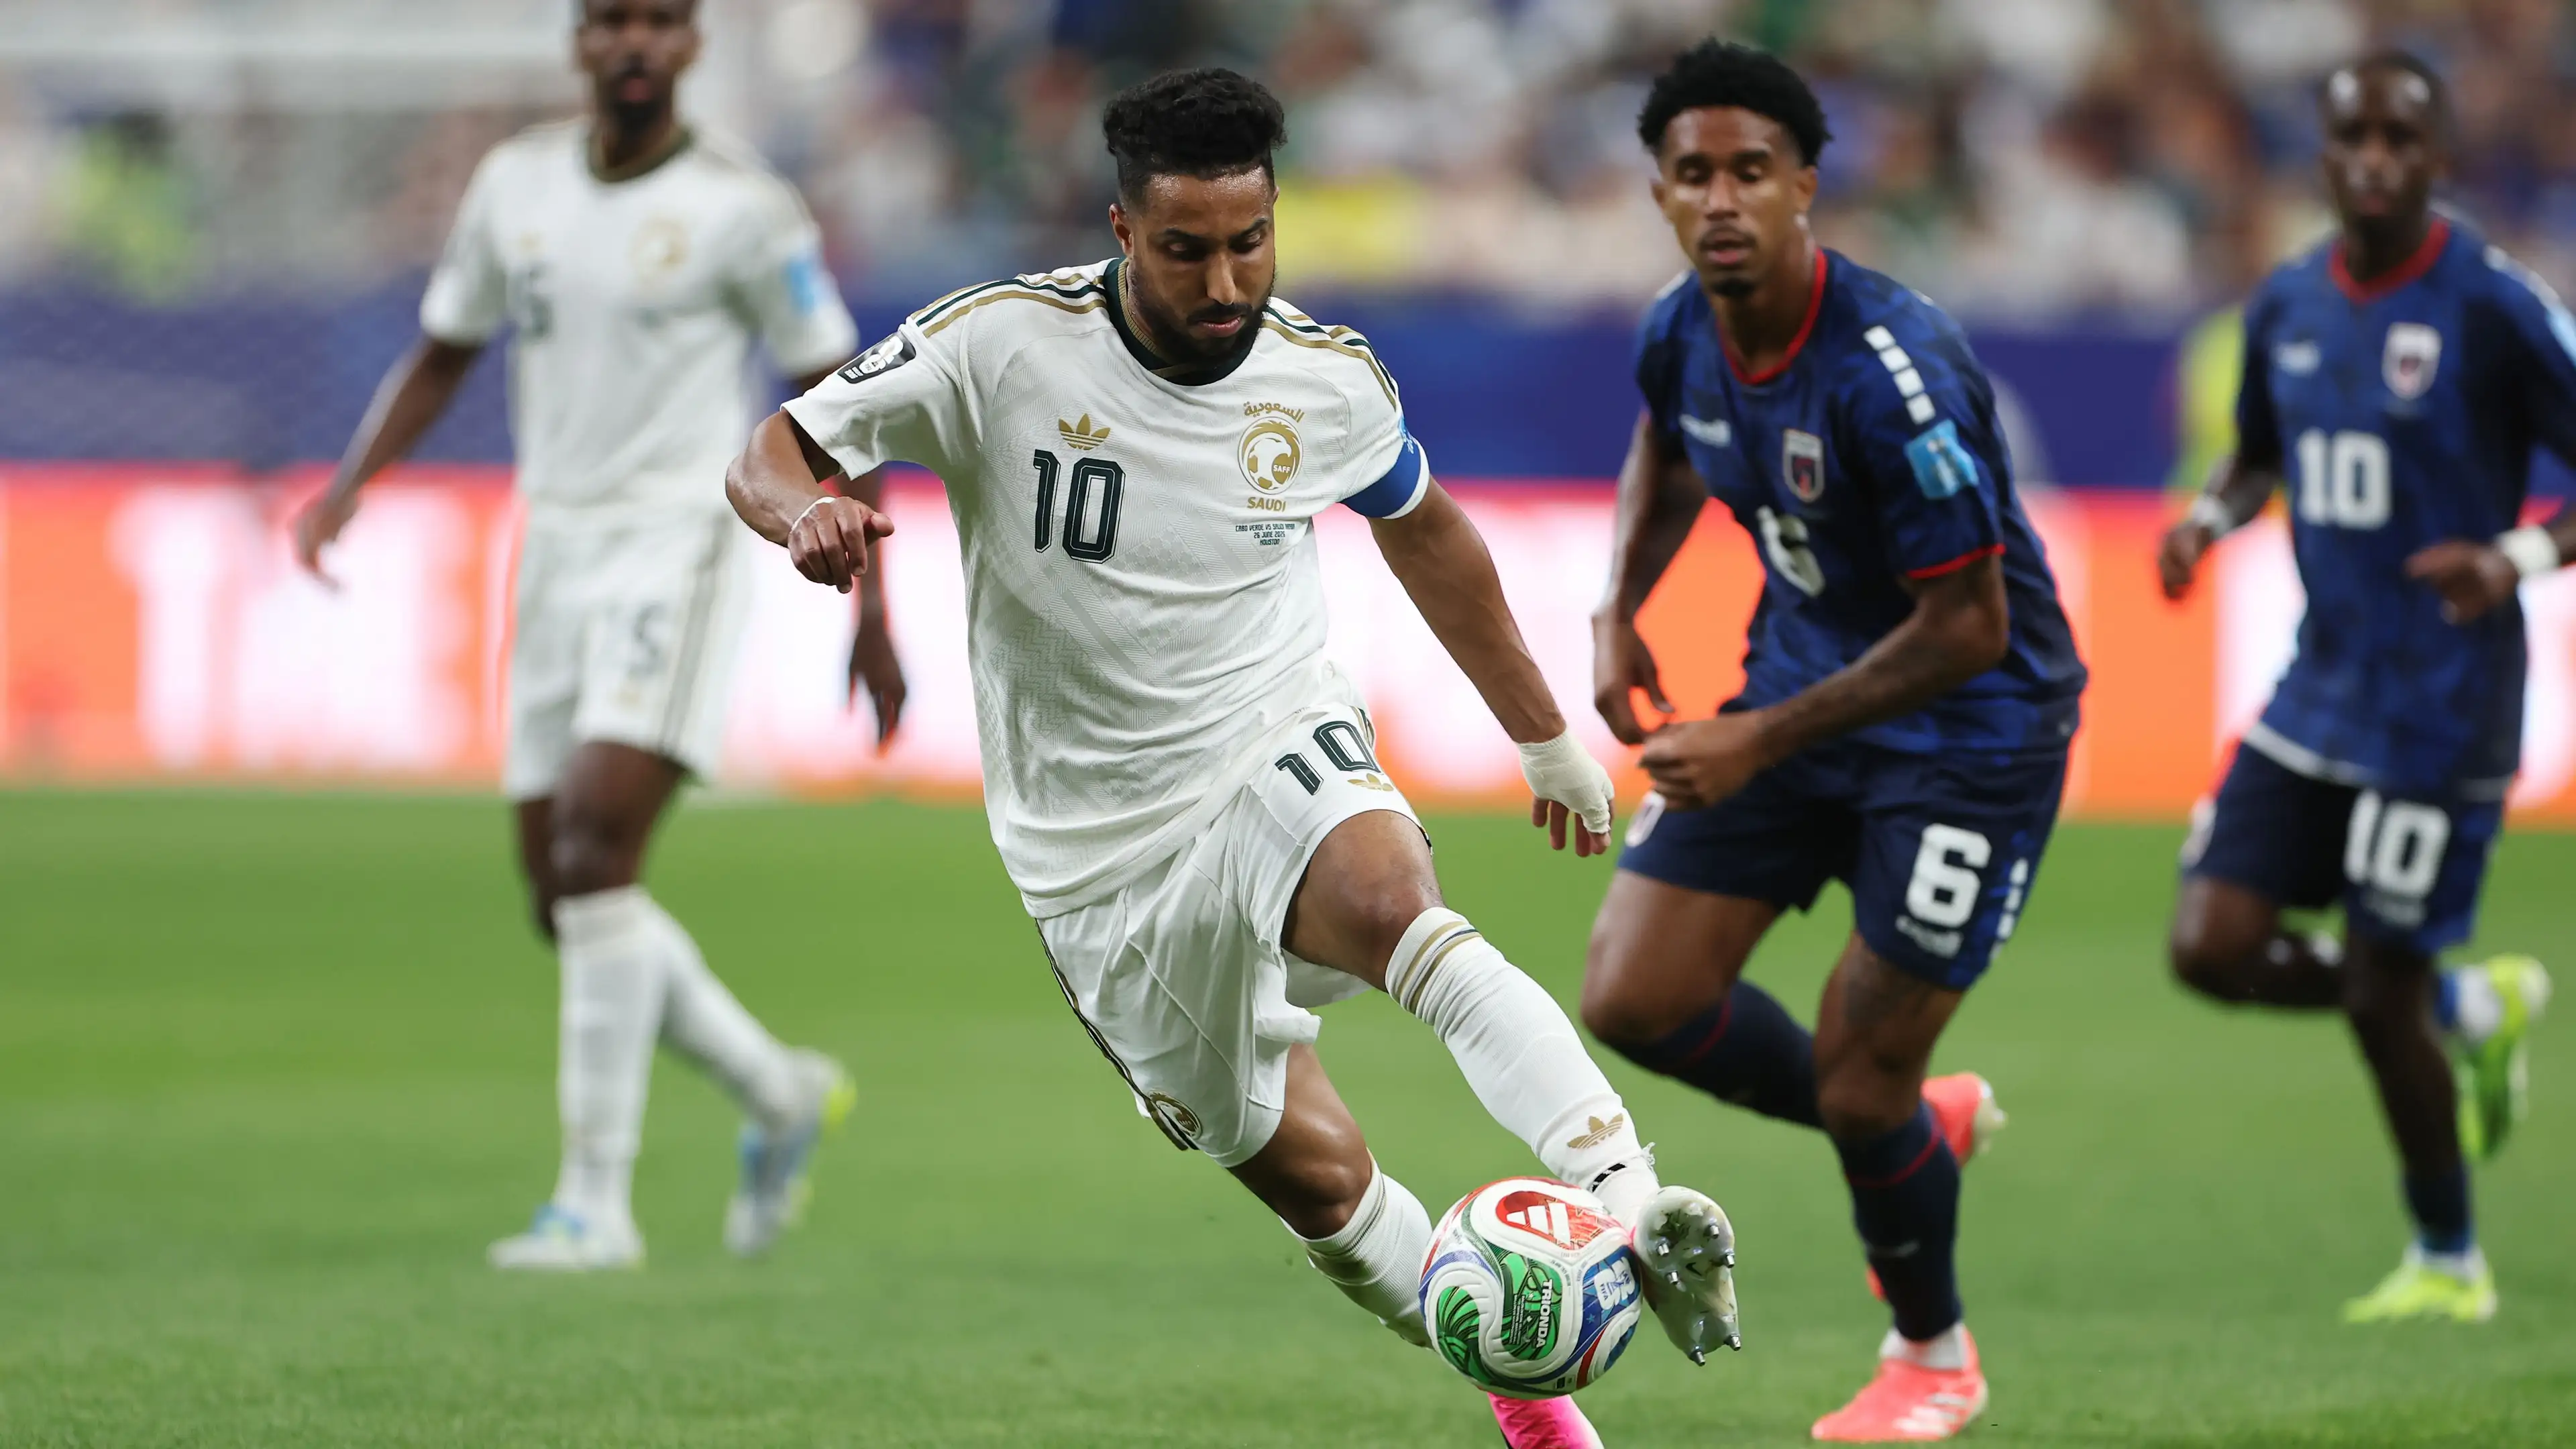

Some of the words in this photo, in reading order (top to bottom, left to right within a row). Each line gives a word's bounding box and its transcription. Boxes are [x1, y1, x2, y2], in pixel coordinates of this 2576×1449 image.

[1244, 401, 1305, 423] السعودية
[1033, 449, 1126, 564] 10
[1247, 496, 1286, 512] SAUDI
[1273, 464, 1290, 474] SAFF
[2297, 426, 2391, 531] 10
[1756, 505, 1825, 596] 6
[1275, 720, 1382, 796] 10
[1905, 822, 1992, 928] 6
[2344, 788, 2451, 898] 10
[1536, 1278, 1553, 1348] TRIONDA
[1599, 1283, 1609, 1301] FIFA
